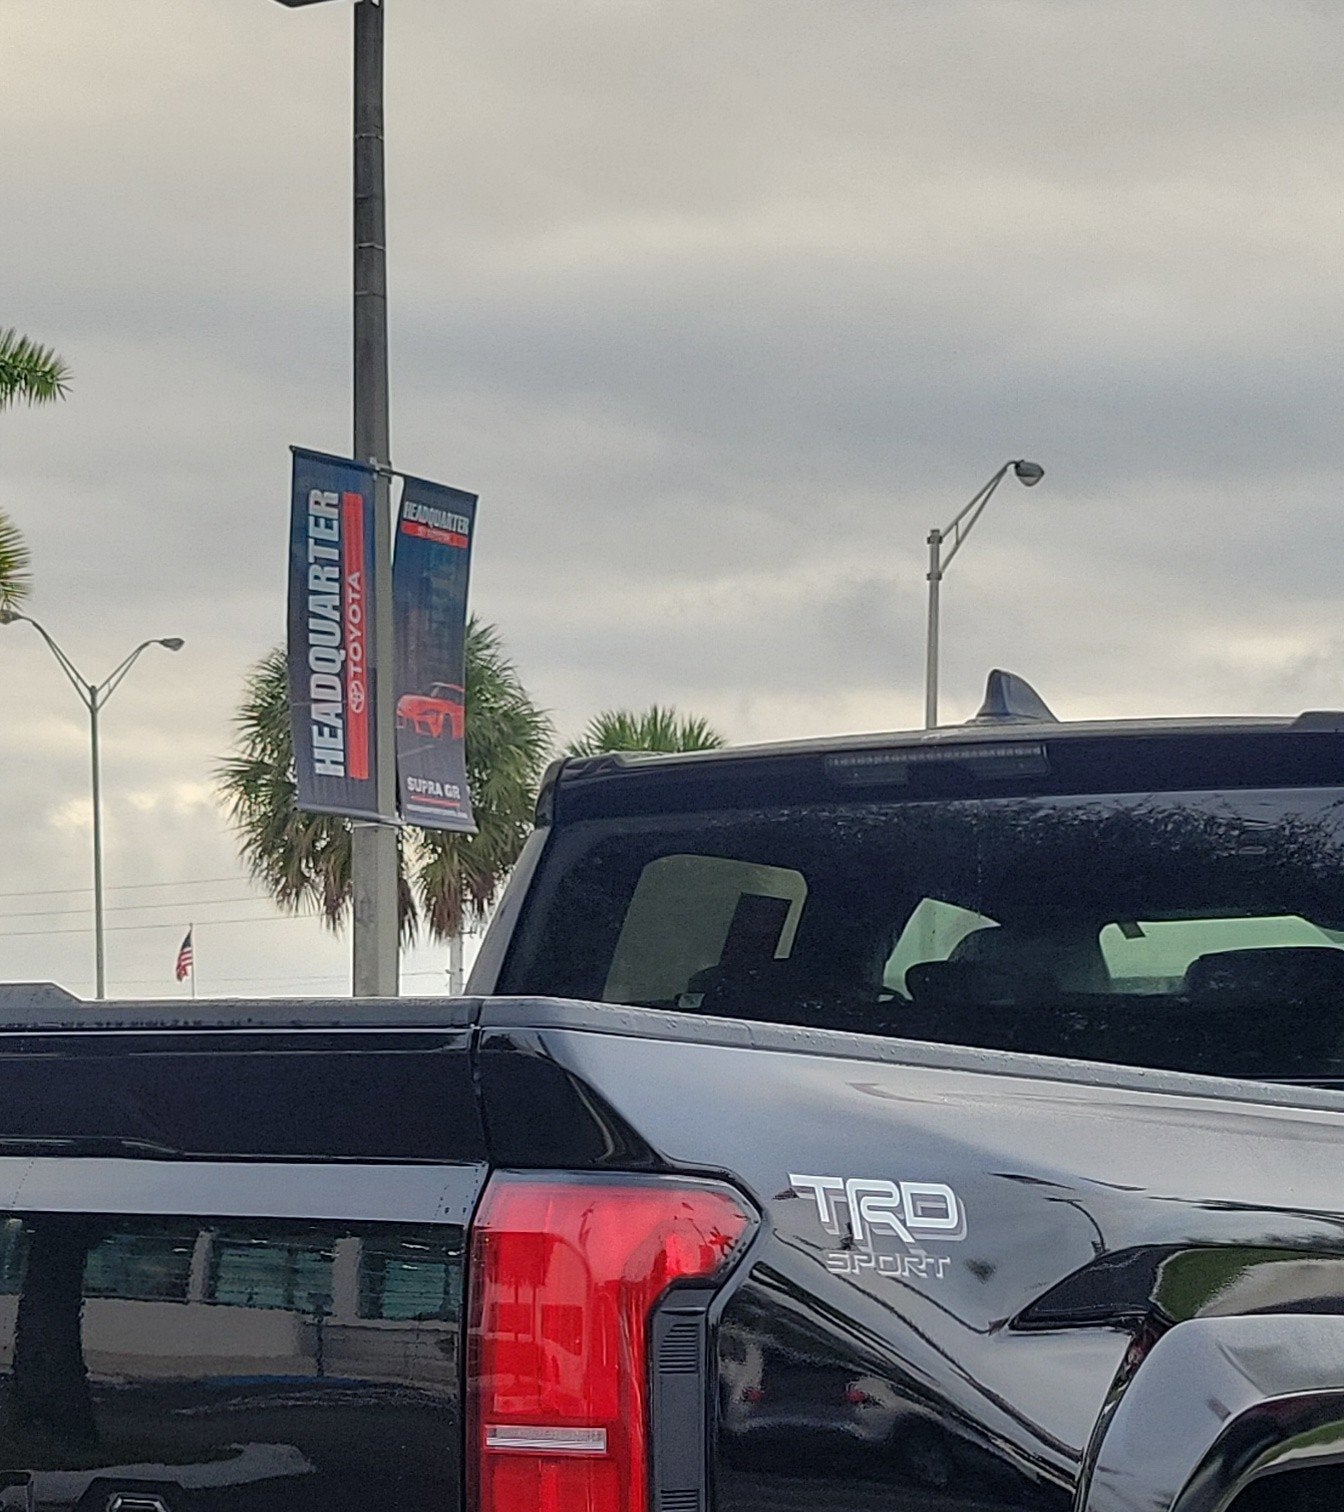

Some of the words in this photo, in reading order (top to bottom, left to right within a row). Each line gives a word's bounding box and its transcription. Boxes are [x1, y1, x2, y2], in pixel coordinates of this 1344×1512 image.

[403, 500, 470, 536] HEADQUARTER
[308, 488, 346, 778] HEADQUARTER
[347, 571, 364, 677] TOYOTA
[406, 776, 444, 797] SUPRA
[444, 783, 461, 800] GR
[787, 1173, 960, 1244] TRD
[827, 1251, 951, 1280] SPORT
